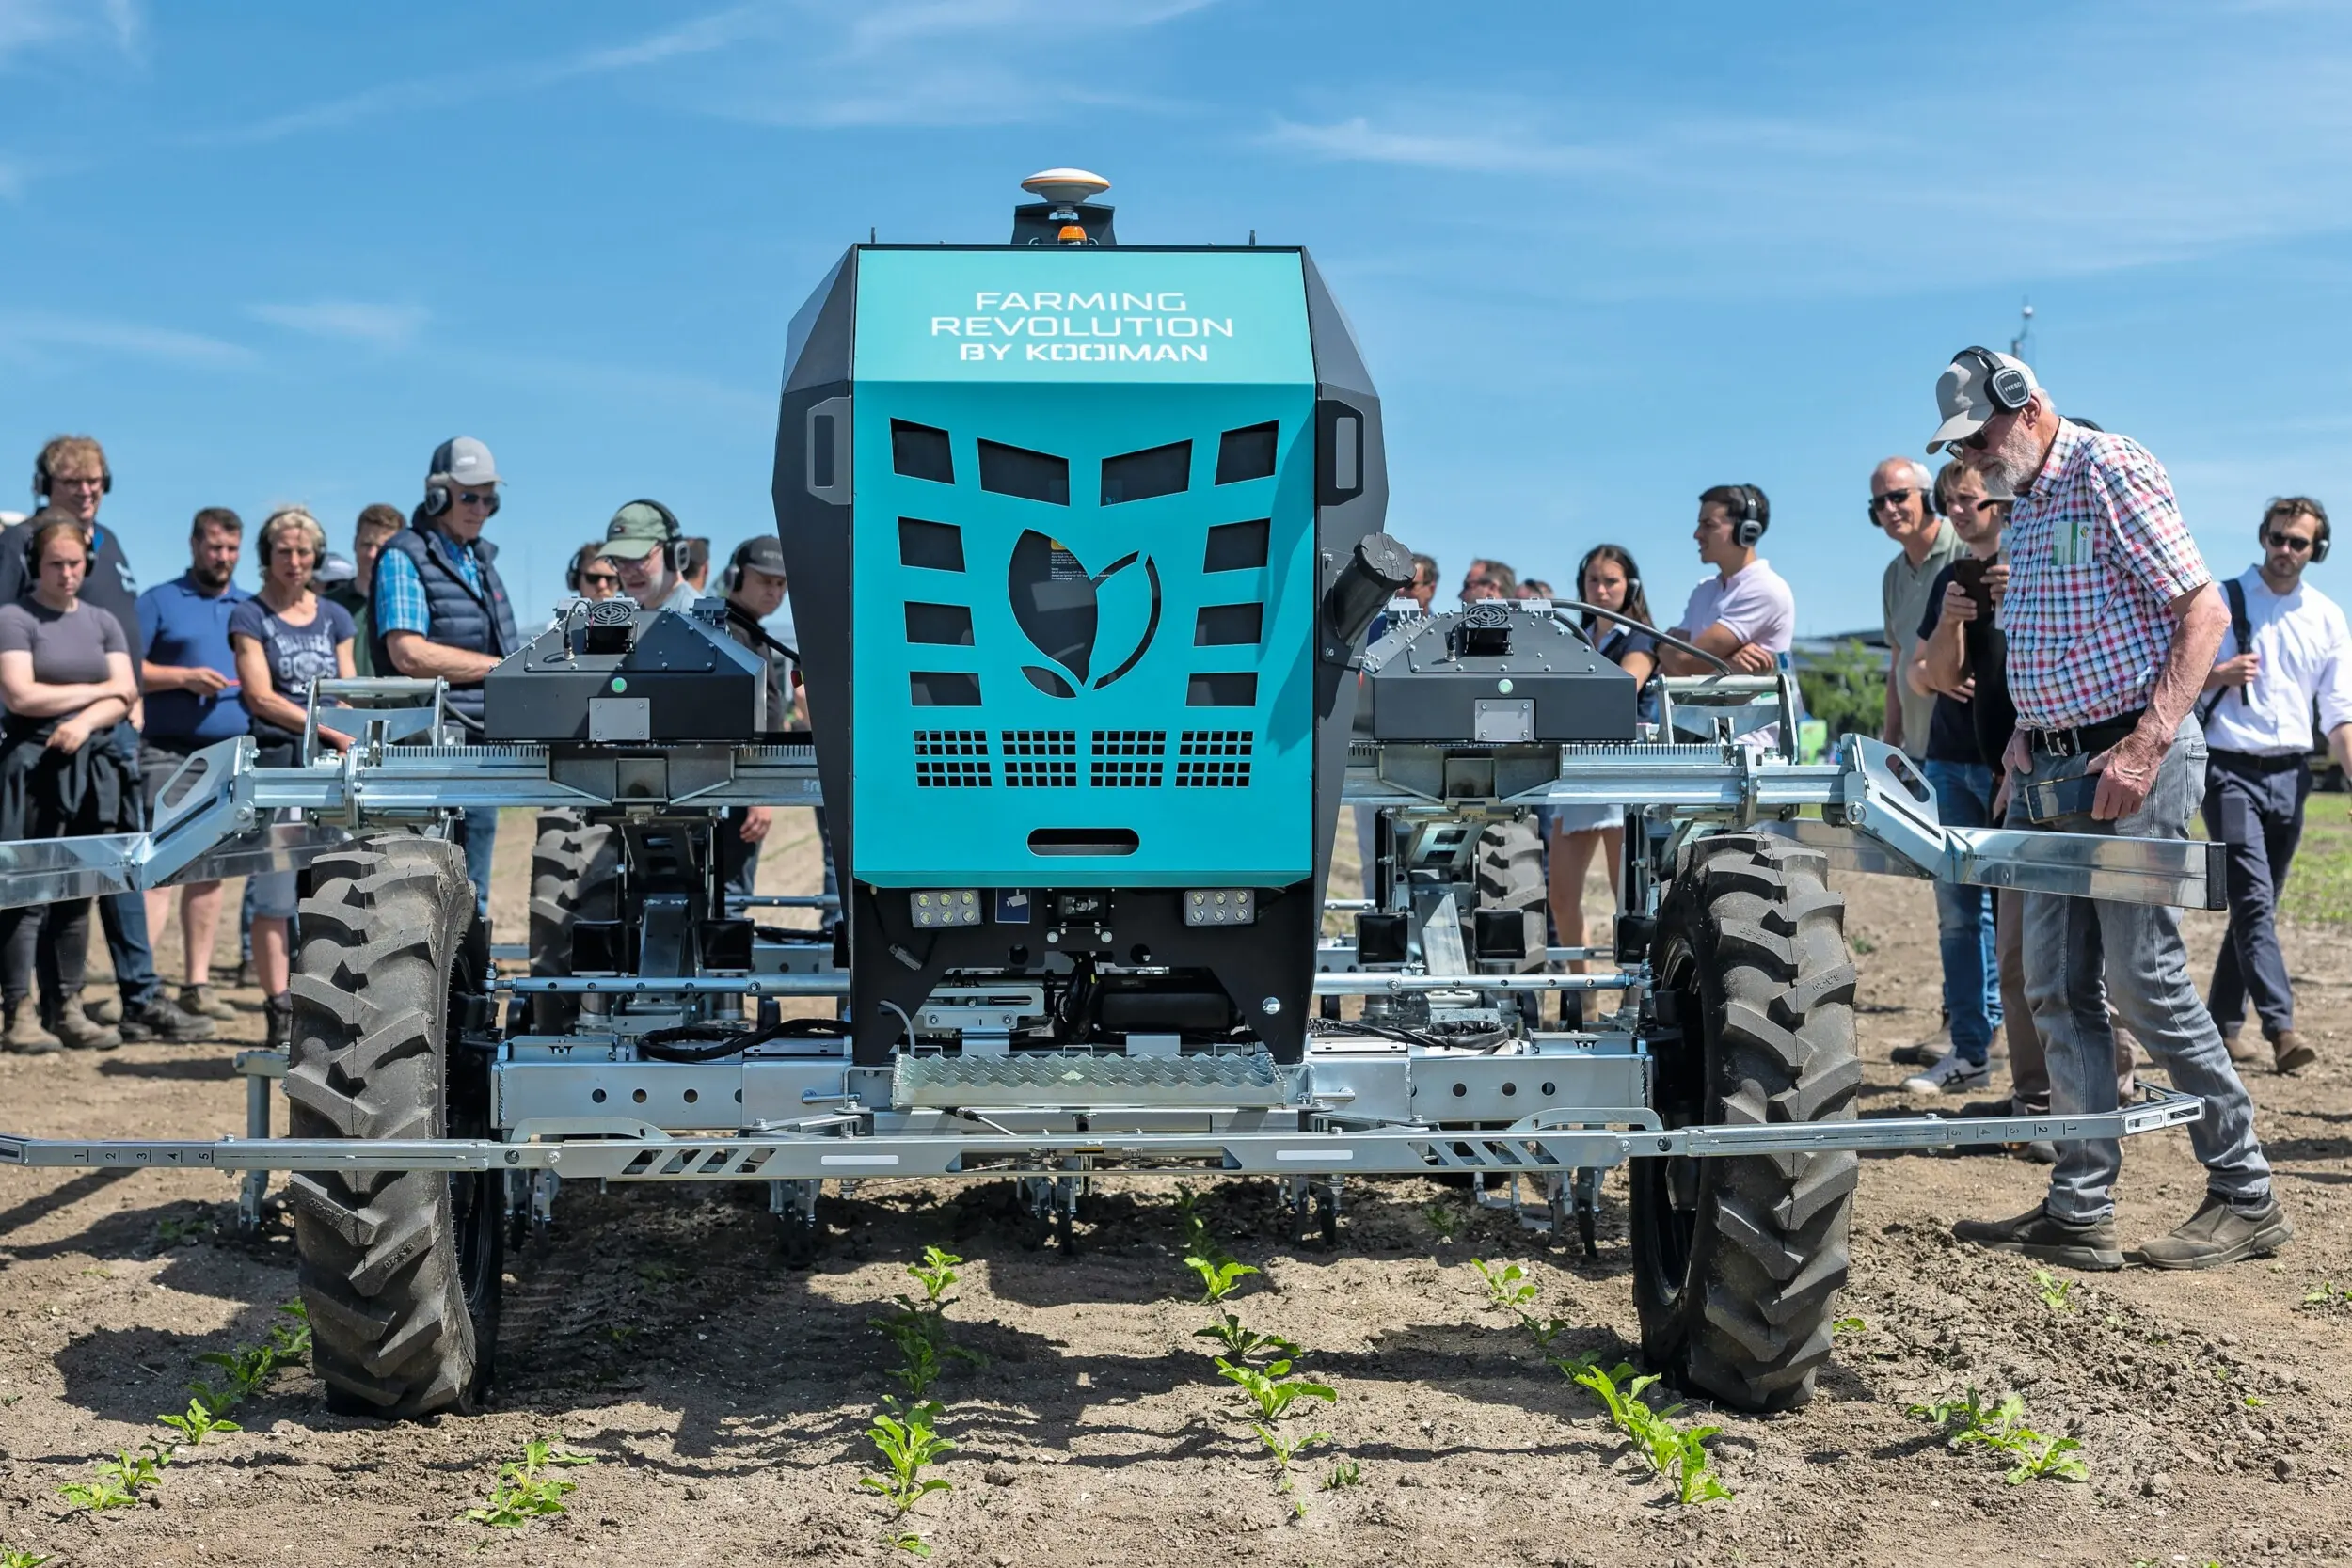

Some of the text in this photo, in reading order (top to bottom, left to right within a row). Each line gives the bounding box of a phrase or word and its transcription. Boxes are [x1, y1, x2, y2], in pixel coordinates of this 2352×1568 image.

[976, 292, 1187, 311] FARMING
[931, 316, 1233, 337] REVOLUTION
[961, 343, 1208, 362] BY KOOIMAN
